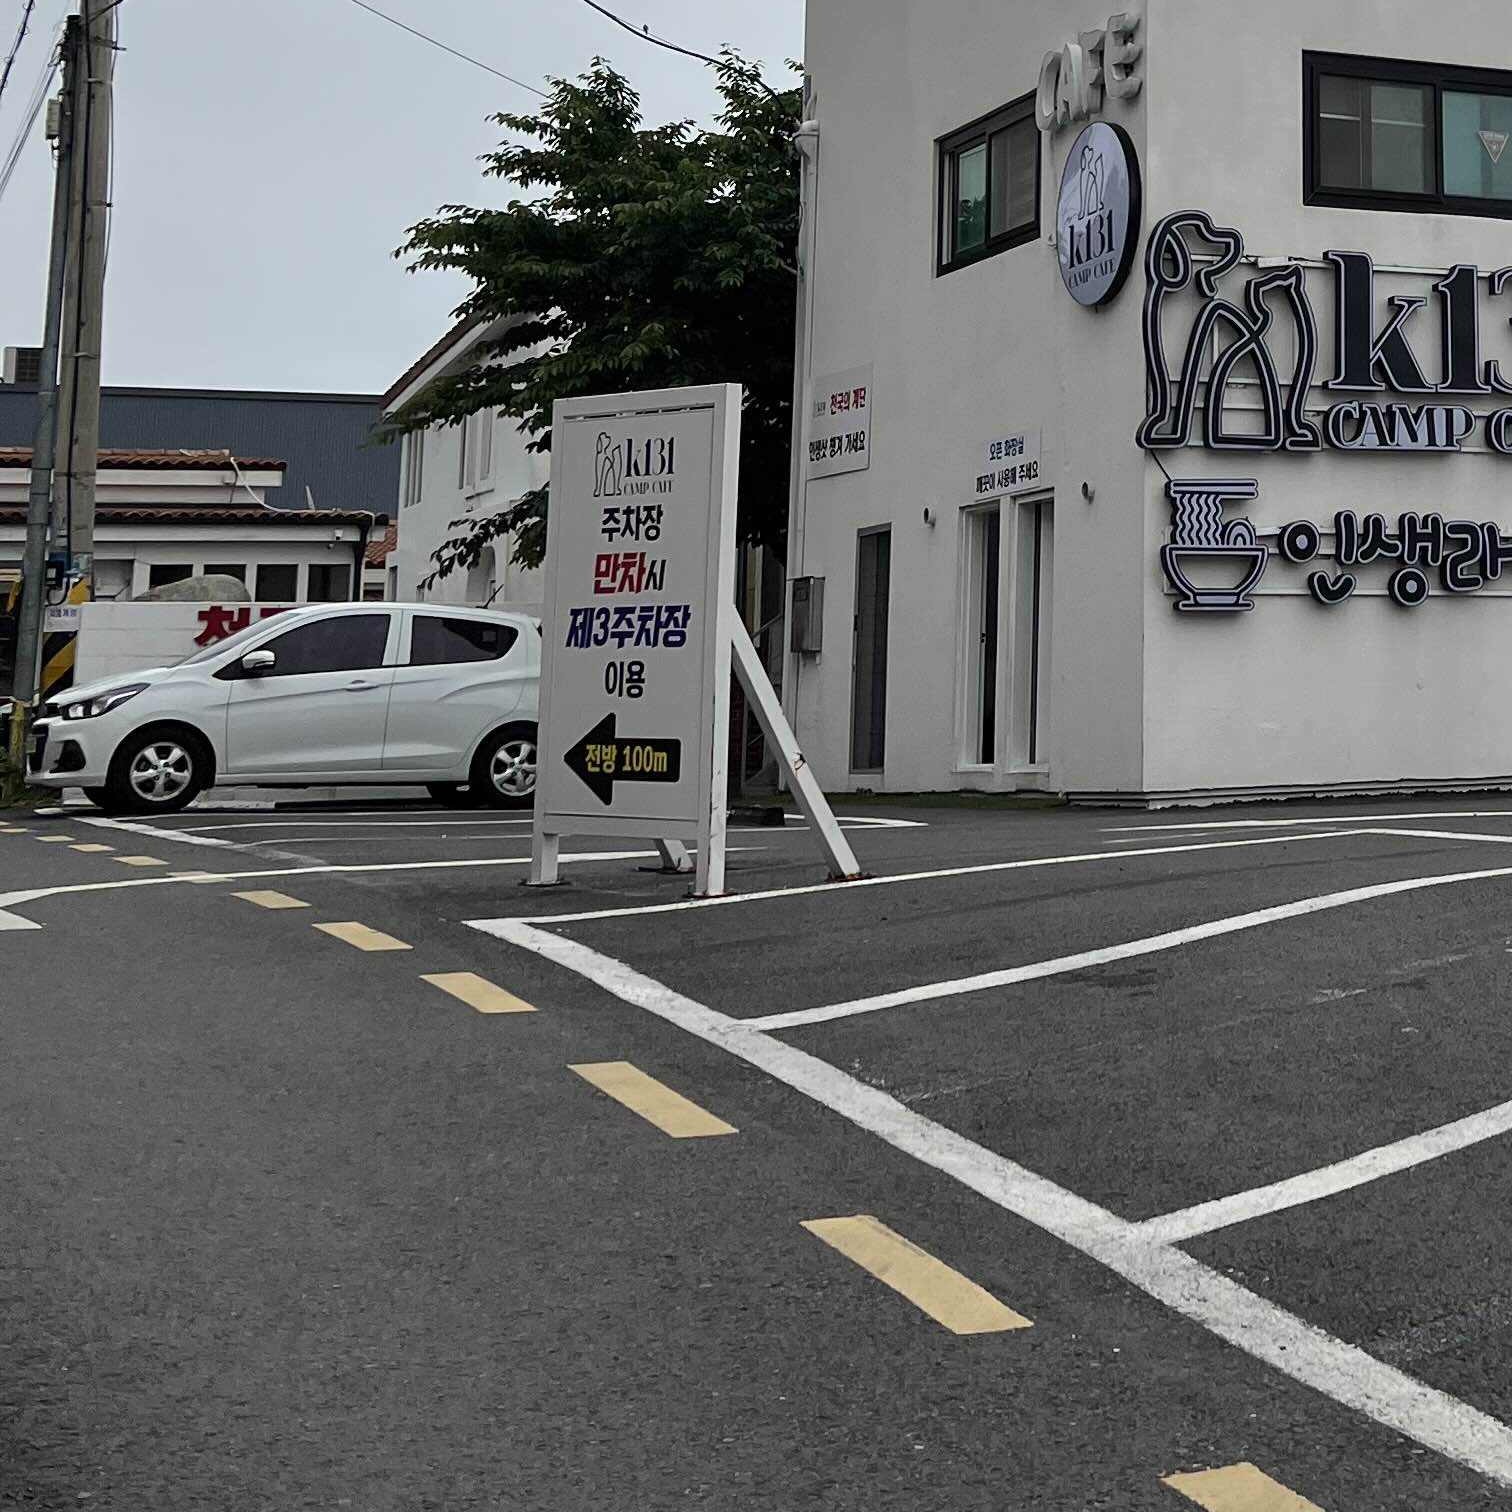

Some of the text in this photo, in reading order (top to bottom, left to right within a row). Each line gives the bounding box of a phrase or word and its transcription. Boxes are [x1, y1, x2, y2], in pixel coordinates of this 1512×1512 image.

[1036, 13, 1142, 131] CAFE
[1068, 209, 1115, 270] k131
[1324, 401, 1476, 452] CAMP
[624, 437, 675, 477] k131
[1018, 460, 1039, 483] 주세요
[601, 504, 663, 542] 주차장
[565, 605, 691, 648] 제3주차장
[605, 661, 645, 698] 이용
[585, 744, 668, 773] 전방 100m
